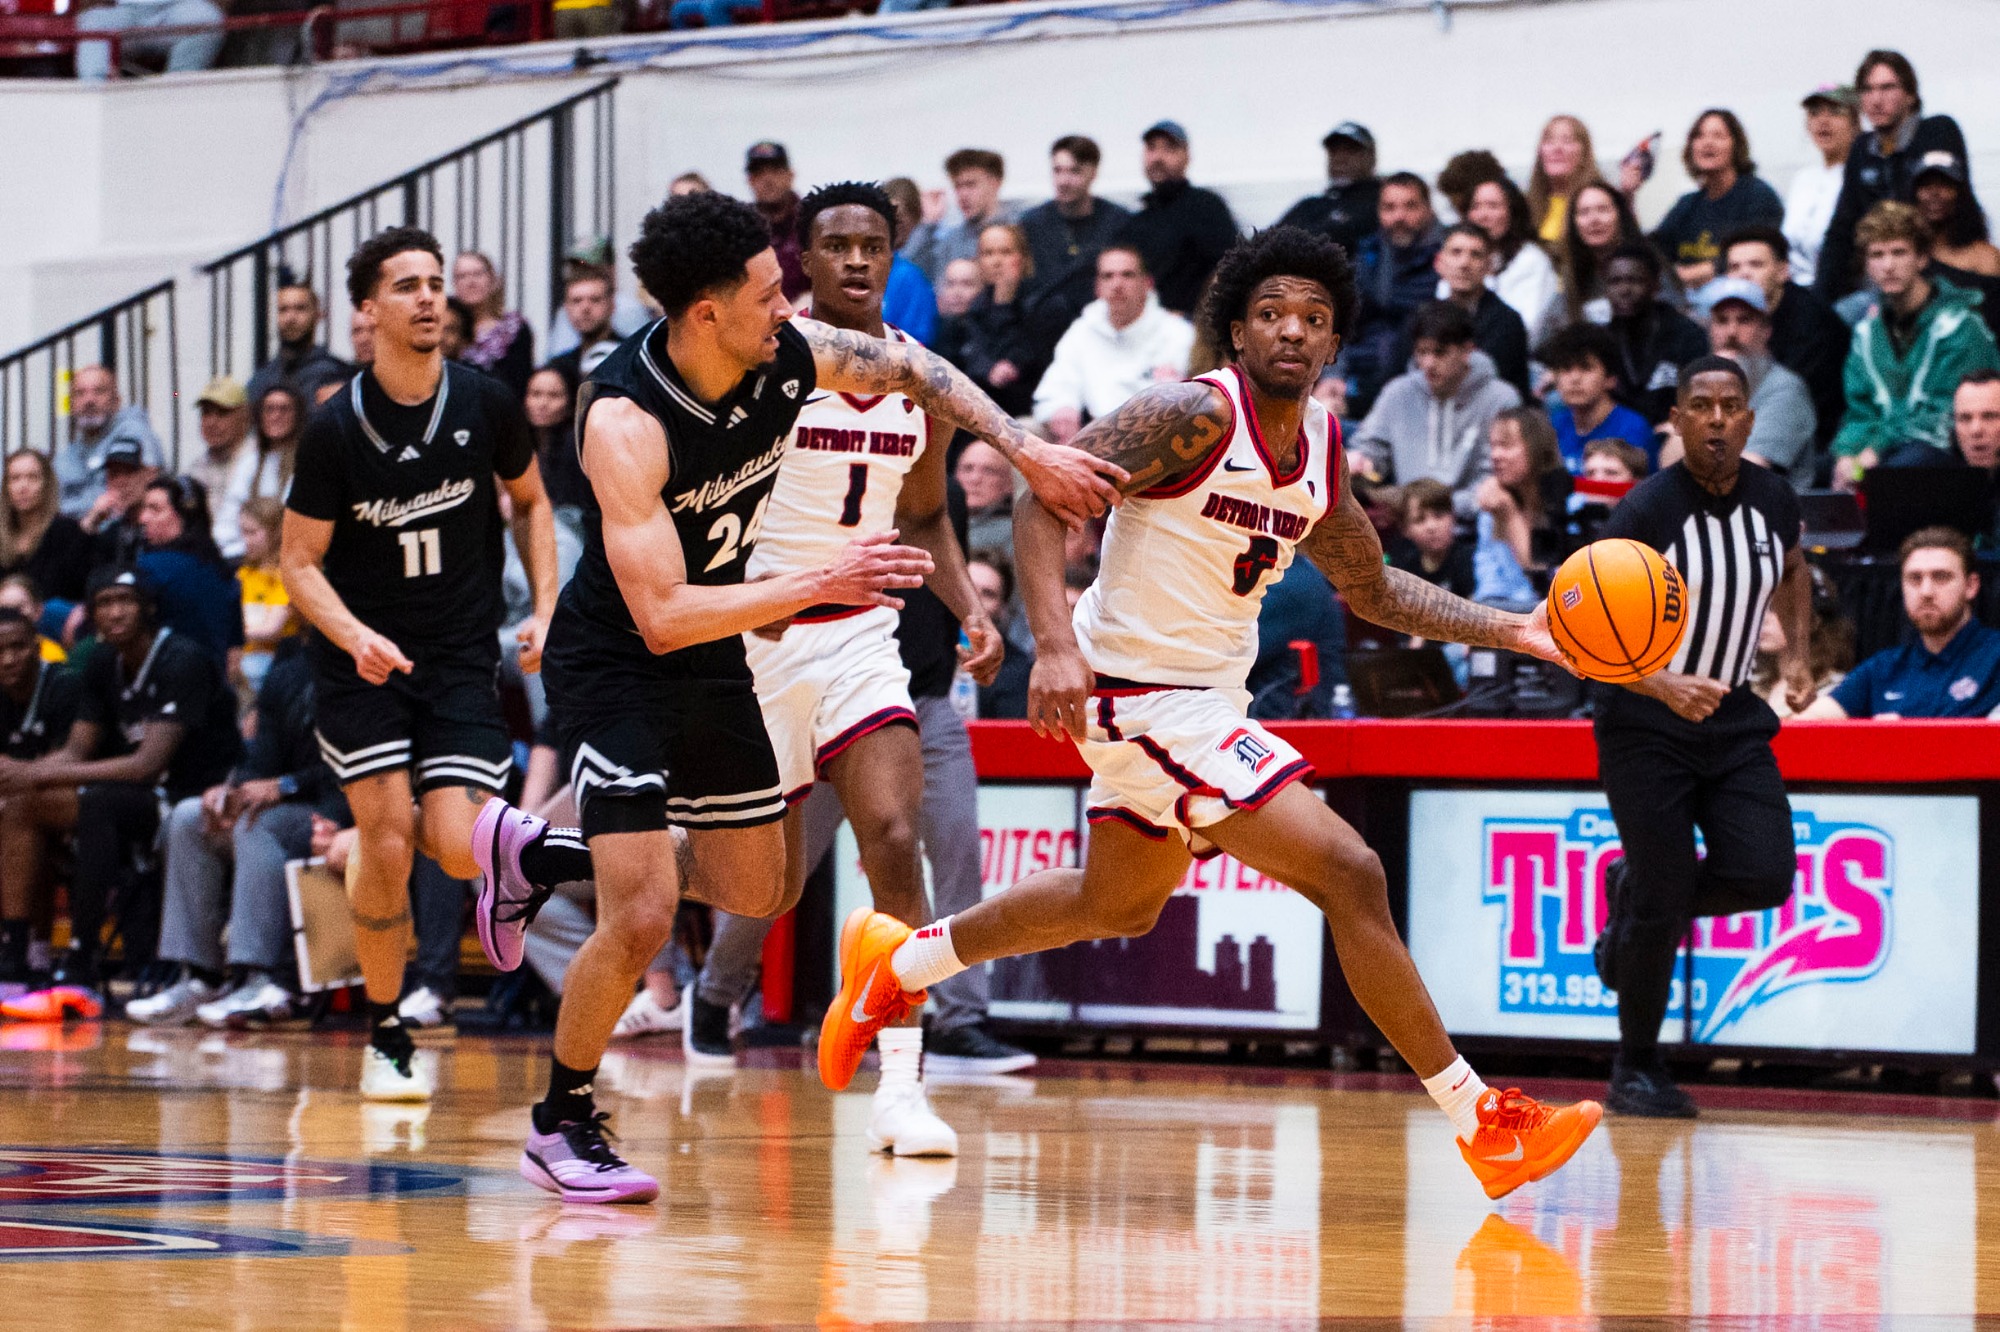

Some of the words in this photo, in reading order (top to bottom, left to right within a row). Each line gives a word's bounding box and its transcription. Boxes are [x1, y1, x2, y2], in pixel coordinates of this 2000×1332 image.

[796, 426, 866, 453] DETROIT
[868, 432, 917, 457] MERCY
[352, 478, 475, 527] Milwaukee
[838, 463, 868, 528] 1
[1200, 492, 1270, 533] DETROIT
[398, 528, 442, 578] 11
